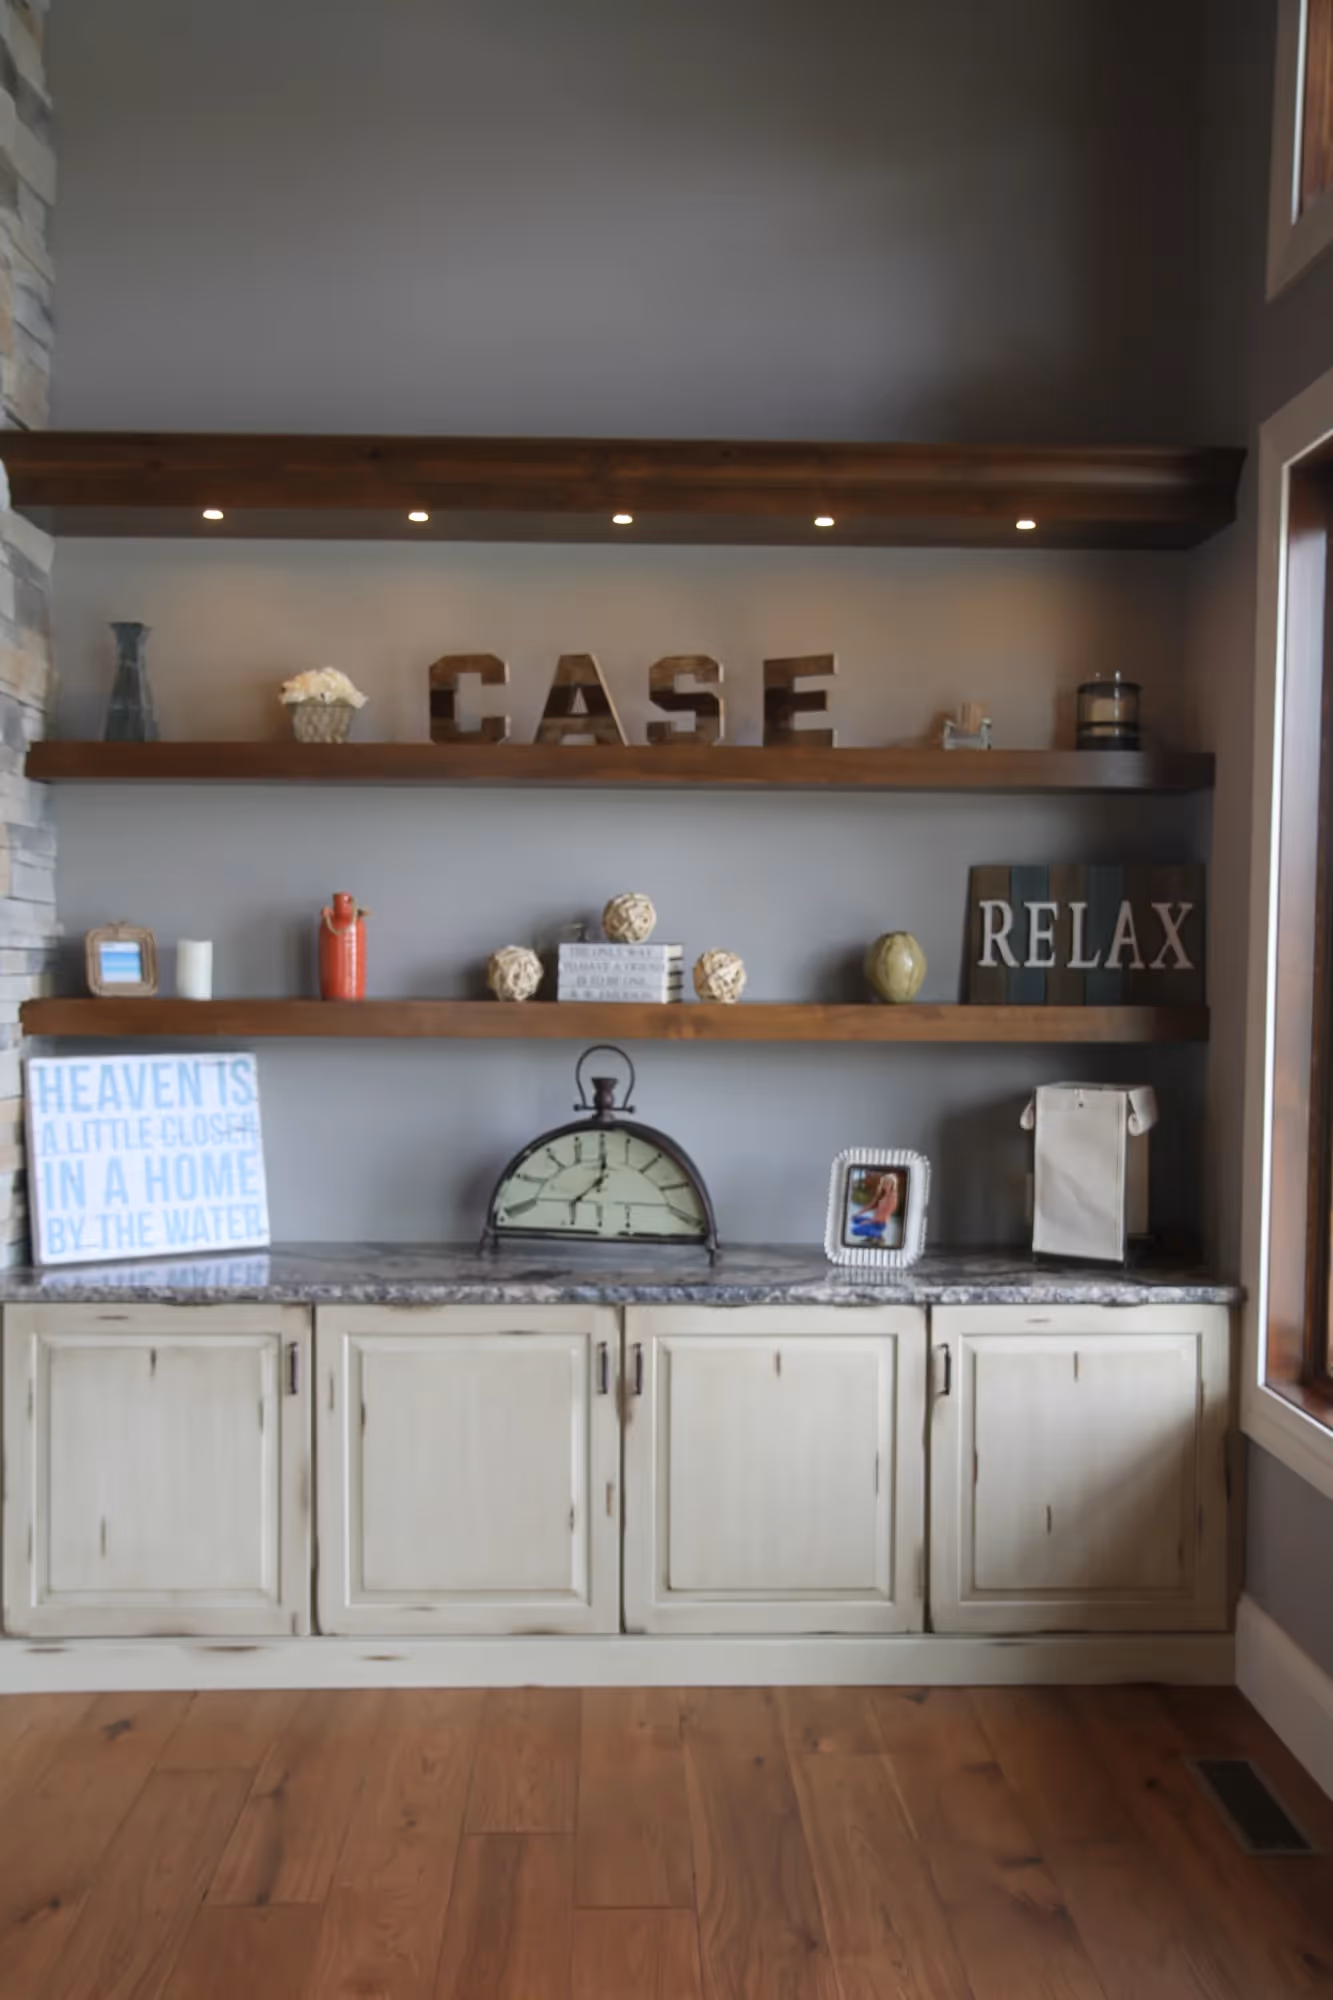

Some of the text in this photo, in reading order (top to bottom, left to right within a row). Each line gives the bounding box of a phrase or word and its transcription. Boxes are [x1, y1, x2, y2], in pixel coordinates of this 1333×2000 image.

[429, 654, 841, 747] CASE
[978, 900, 1194, 969] RELAX
[38, 1059, 256, 1113] HEAVEN IS
[42, 1120, 58, 1154] A
[67, 1117, 152, 1153] LITTLE
[45, 1150, 258, 1211] IN A HOME
[49, 1203, 261, 1255] BY THE WATER
